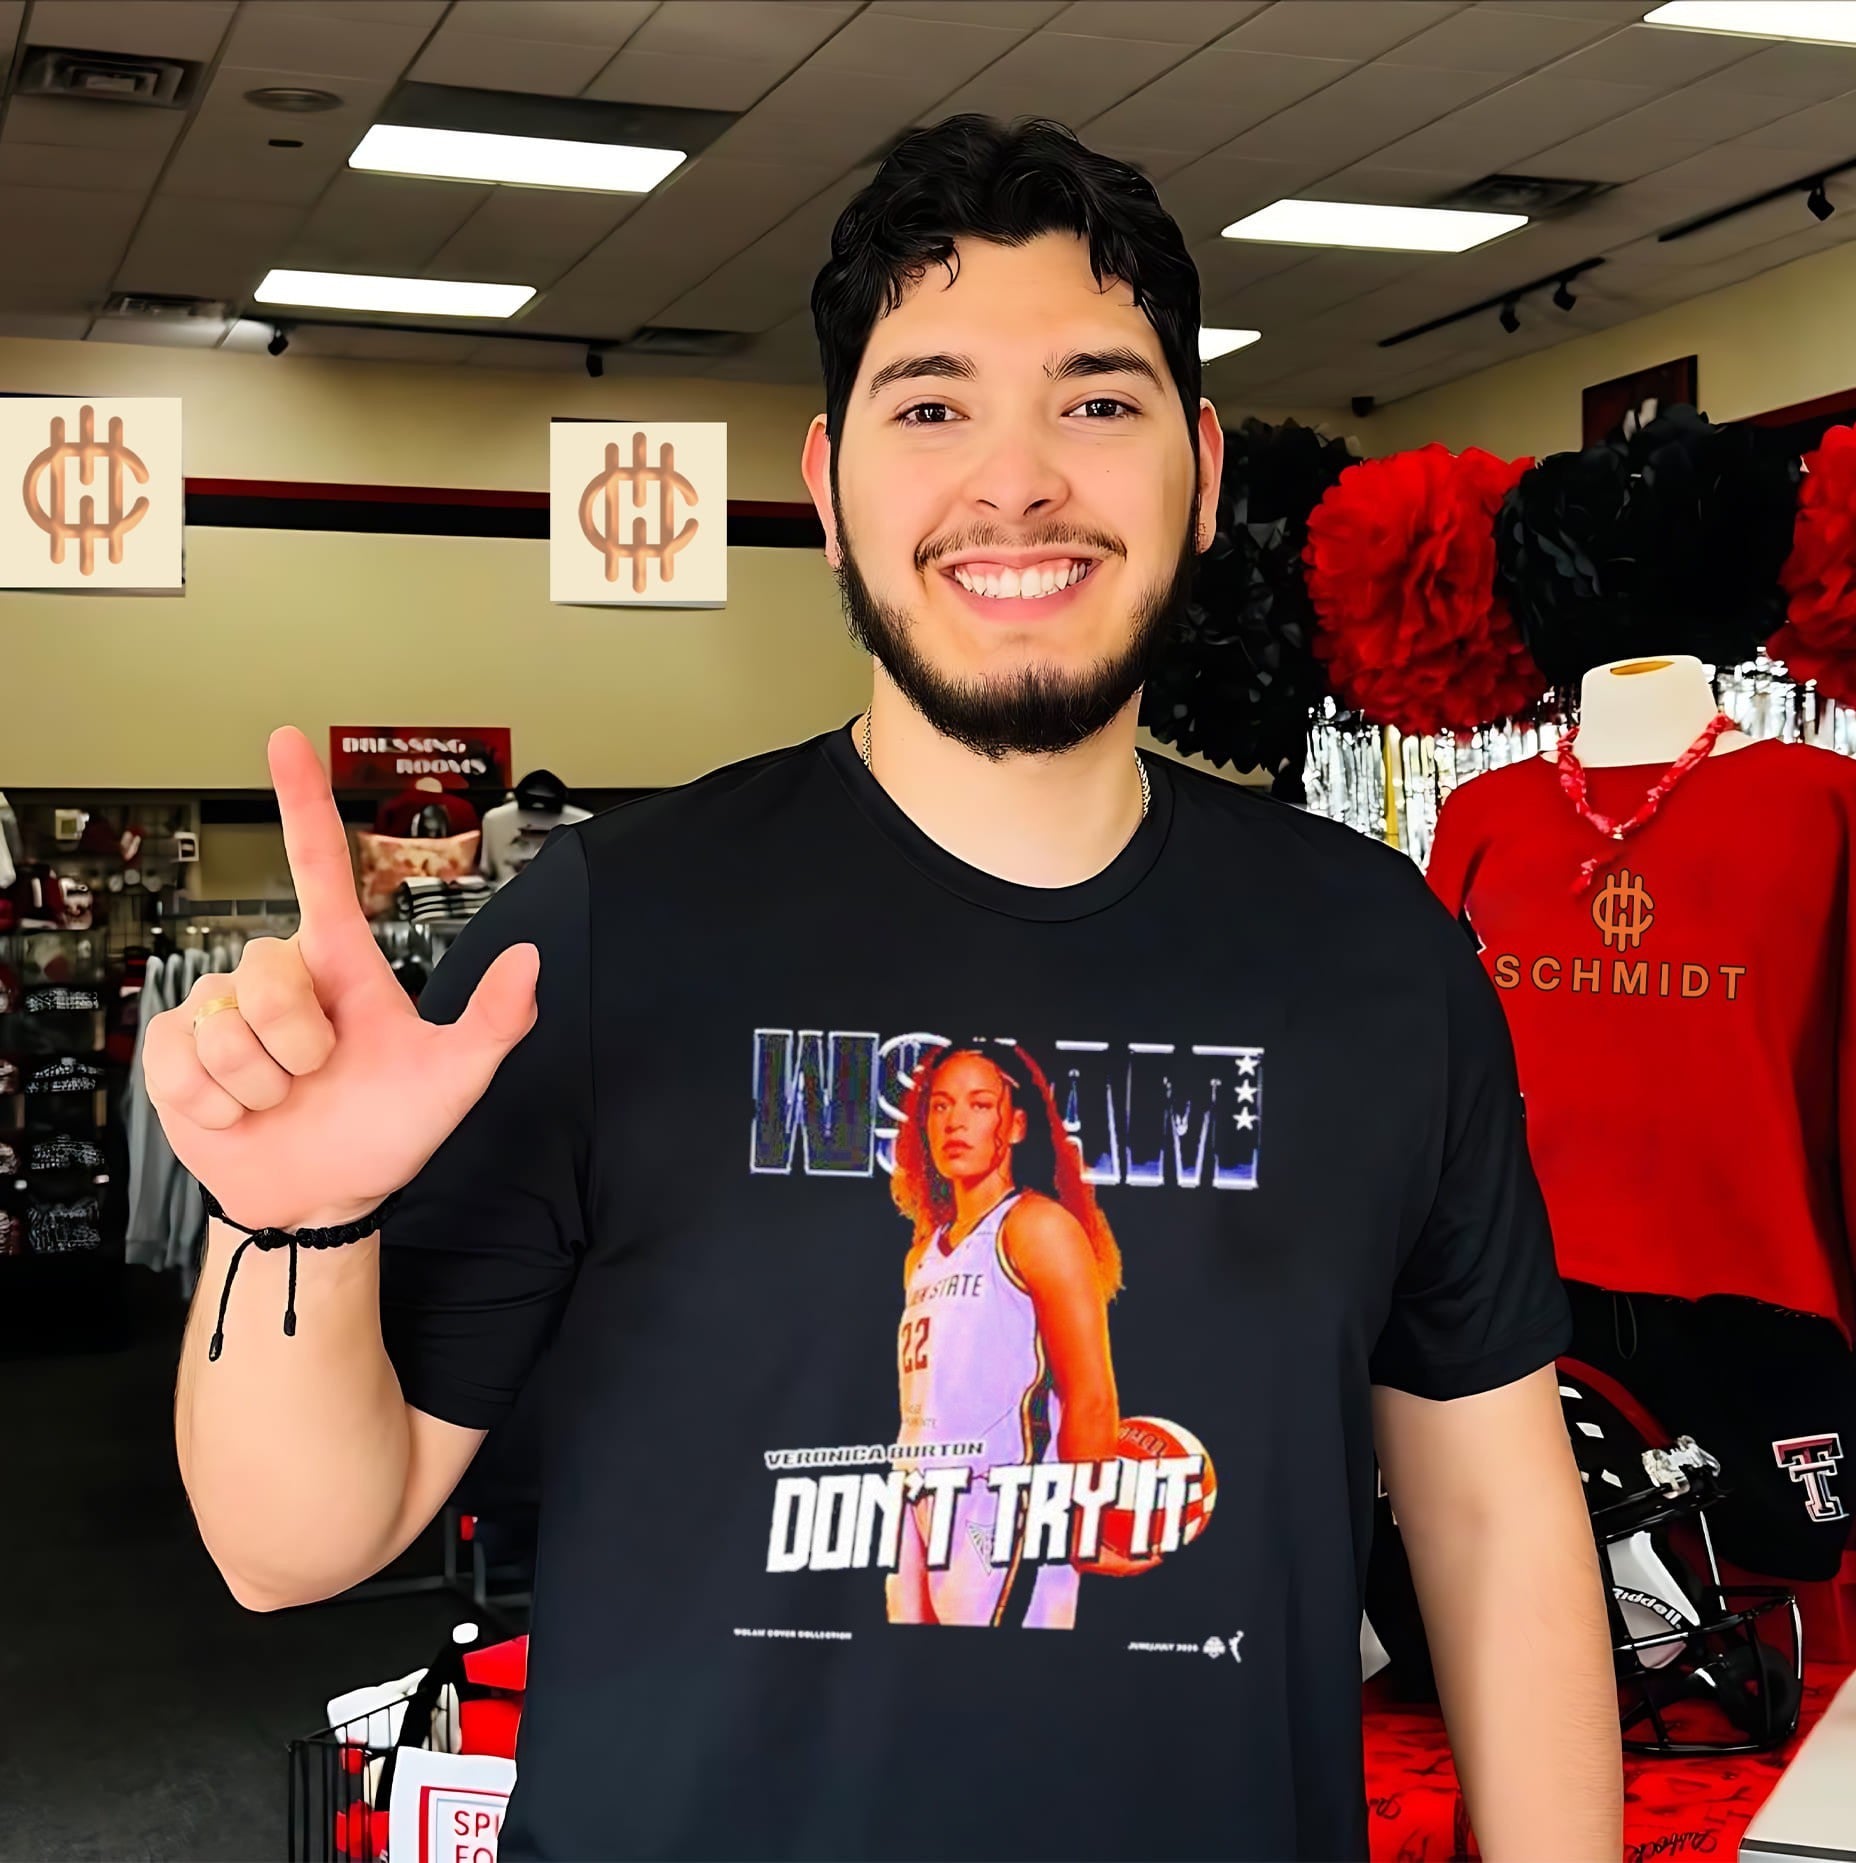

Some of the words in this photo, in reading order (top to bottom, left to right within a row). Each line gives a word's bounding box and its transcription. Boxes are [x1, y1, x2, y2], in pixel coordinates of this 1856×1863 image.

[342, 737, 467, 754] DRESSING
[396, 758, 487, 774] ROOMS
[1494, 954, 1747, 1000] SCHMIDT
[901, 1316, 930, 1374] 22
[766, 1446, 886, 1469] VERONICA
[889, 1442, 985, 1463] BURTON
[766, 1467, 971, 1572] DON'T
[987, 1461, 1120, 1563] TRY
